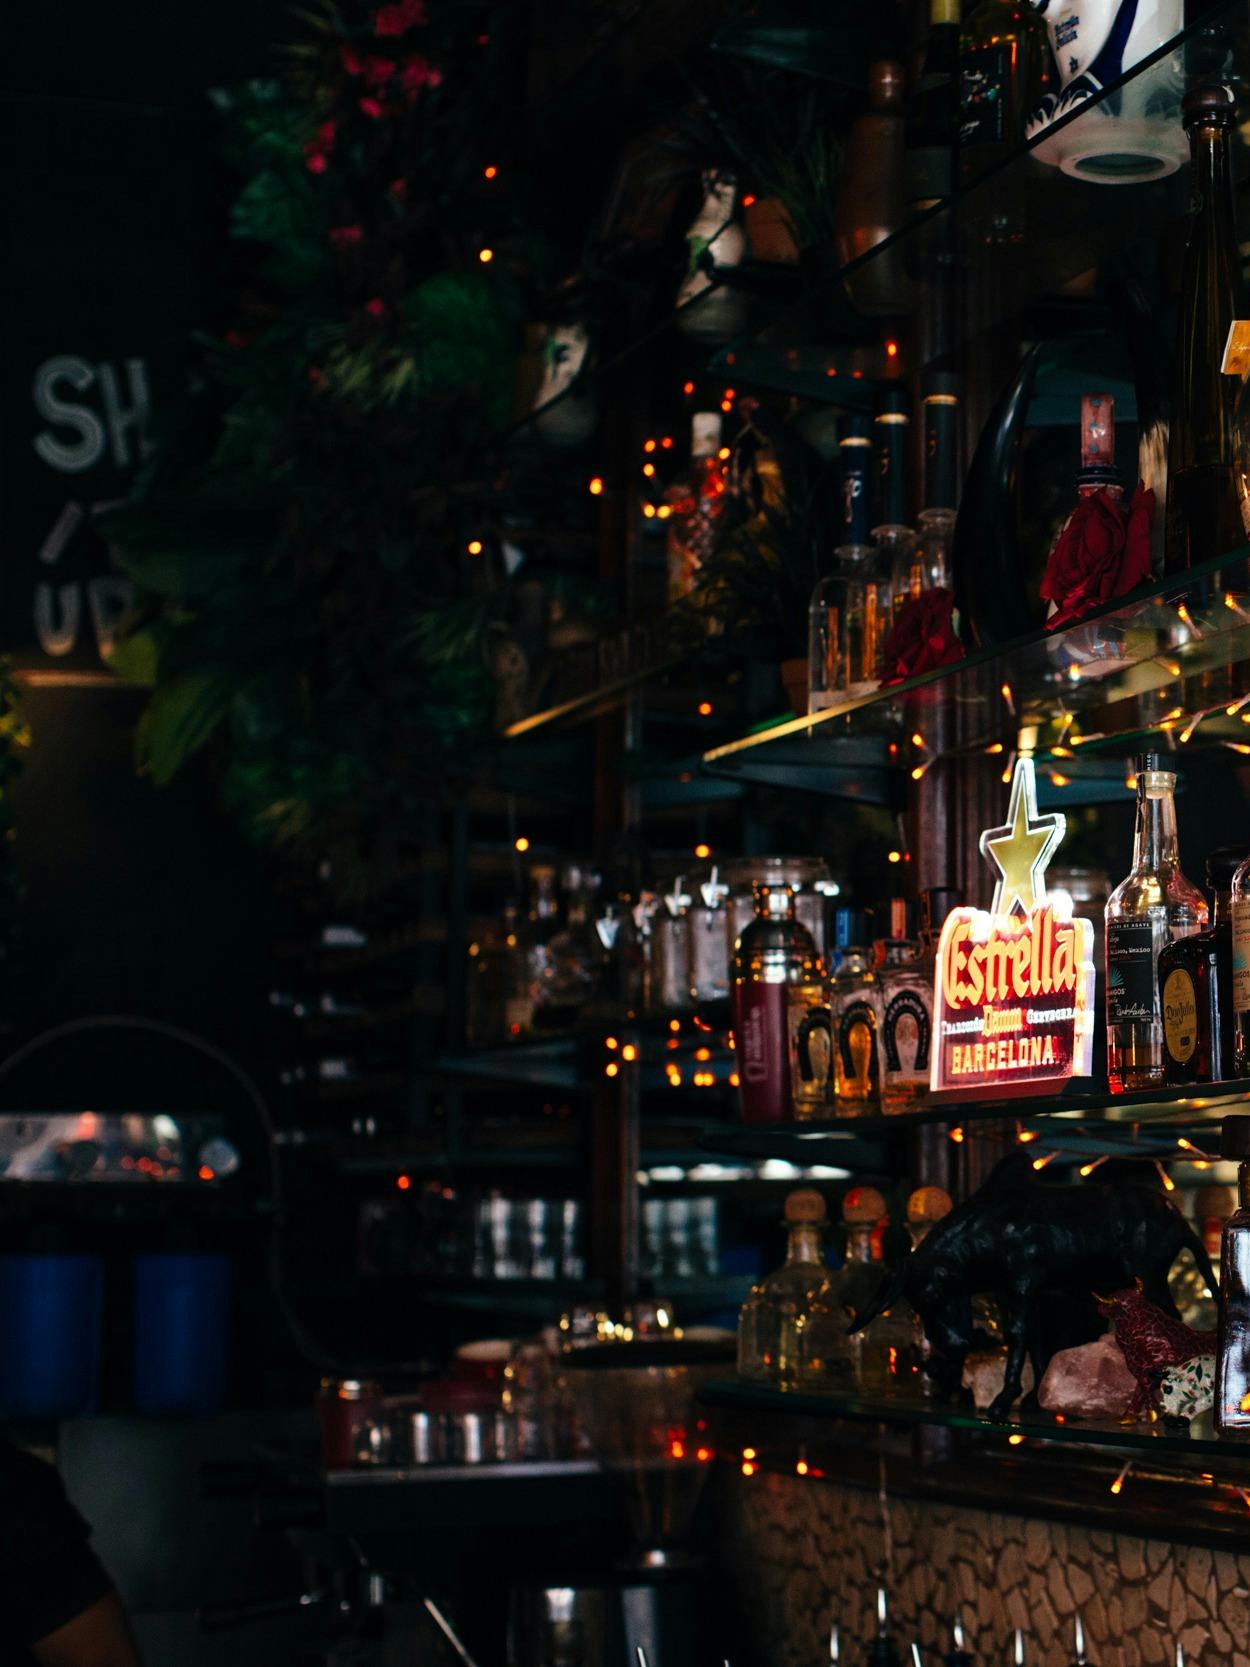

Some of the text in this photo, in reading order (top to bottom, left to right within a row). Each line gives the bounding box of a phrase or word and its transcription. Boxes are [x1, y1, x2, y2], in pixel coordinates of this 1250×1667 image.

[34, 355, 152, 472] SH
[942, 906, 1077, 1010] Estrella
[951, 1034, 1055, 1075] BARCELONA
